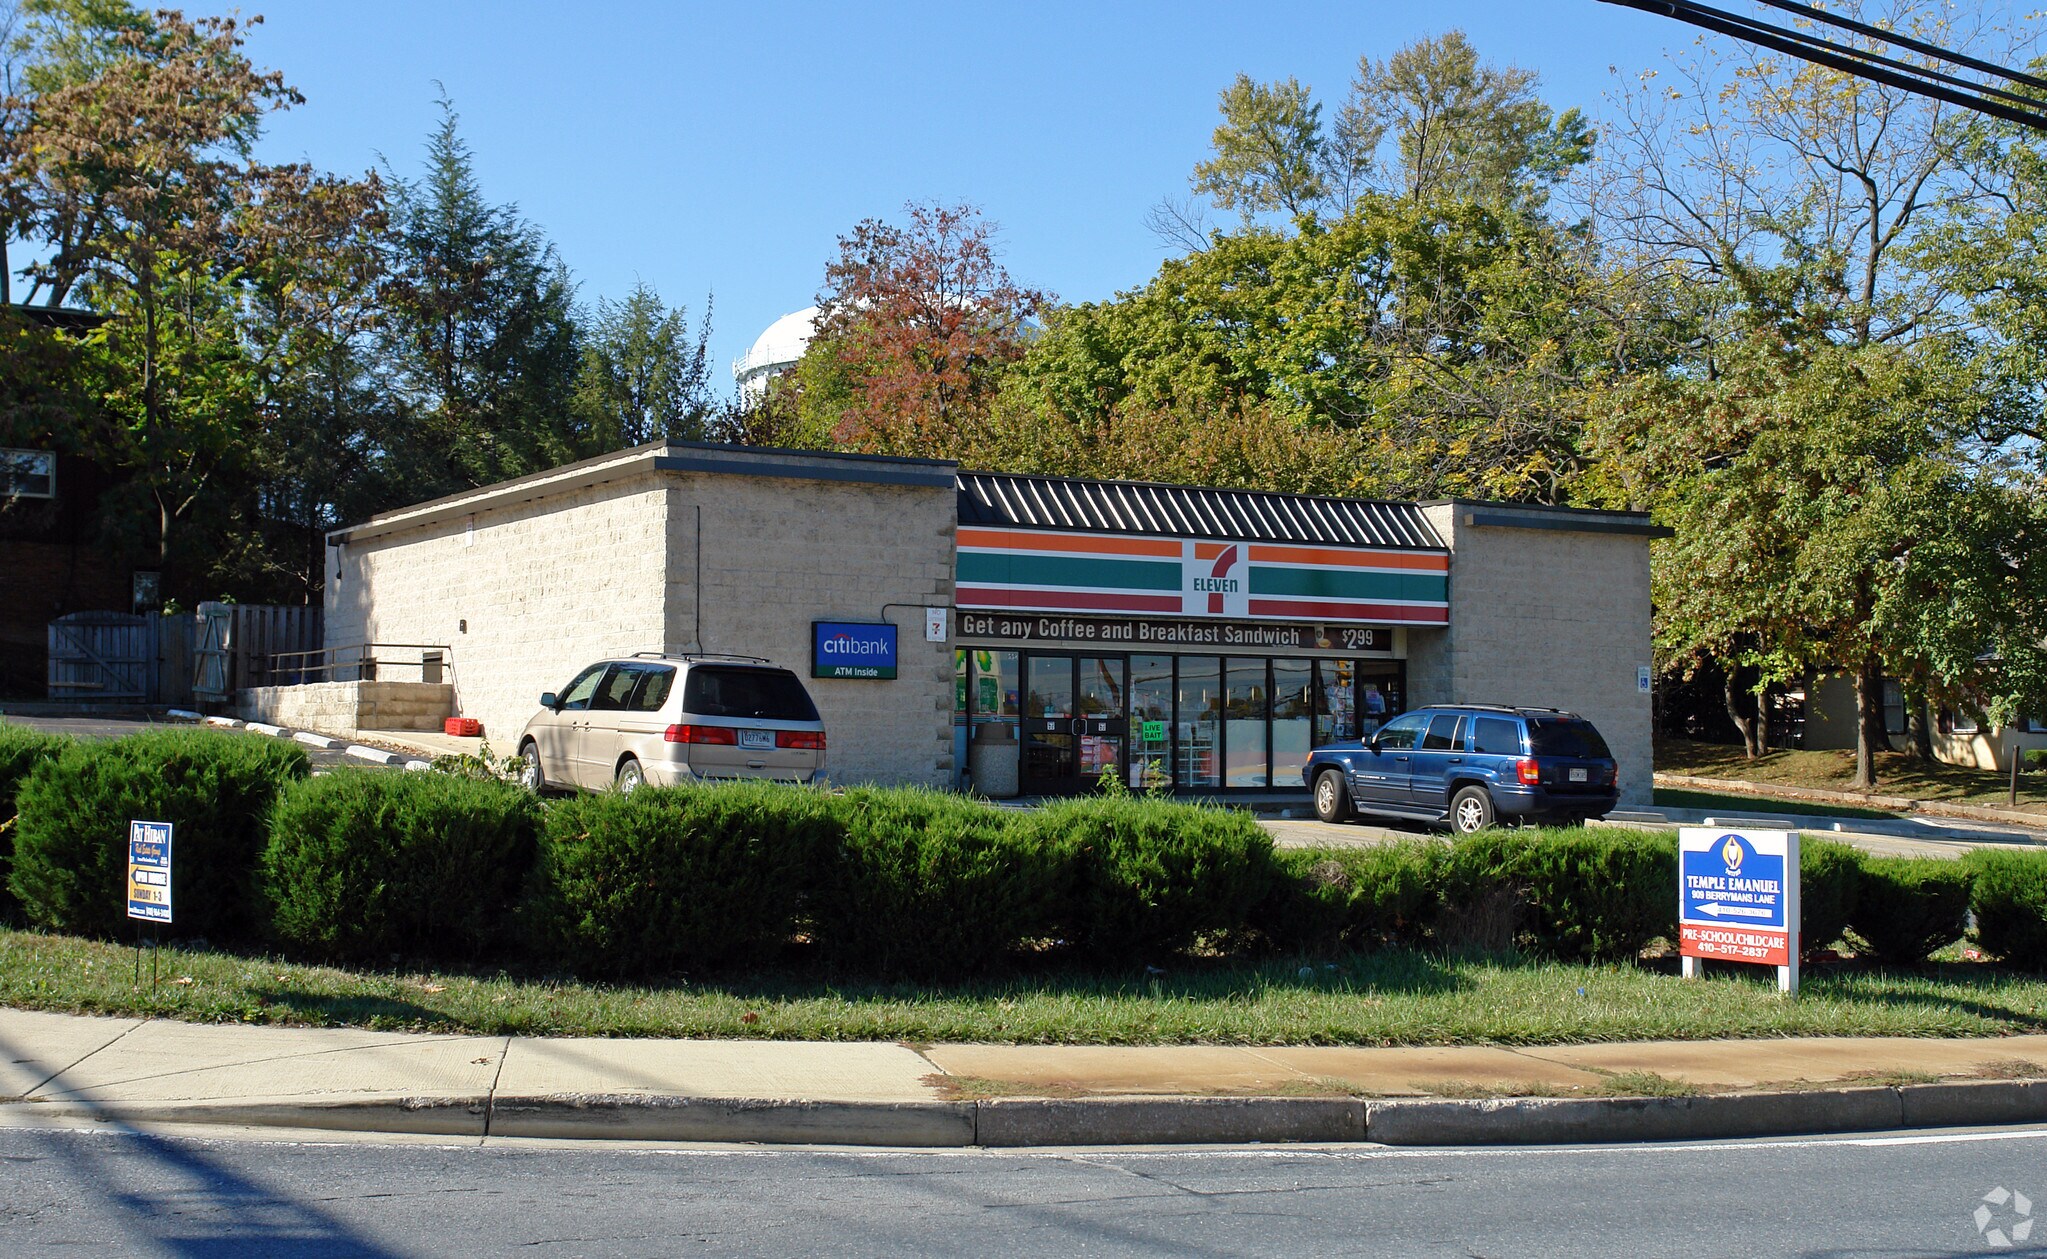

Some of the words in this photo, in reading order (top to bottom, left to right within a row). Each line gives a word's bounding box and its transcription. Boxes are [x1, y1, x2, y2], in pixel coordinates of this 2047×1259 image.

[1195, 543, 1237, 613] 7
[963, 615, 994, 635] Get
[1000, 620, 1032, 639] any
[1039, 618, 1096, 639] Coffee
[1101, 620, 1134, 641] and
[1139, 622, 1219, 644] Breakfast
[1224, 624, 1300, 645] Sandwich
[823, 634, 889, 655] citibank
[834, 667, 852, 676] ATM
[854, 667, 878, 677] Inside
[1687, 876, 1726, 890] TEMPLE
[1728, 878, 1780, 894] EMANUEL
[134, 889, 151, 900] SUNDAY
[1691, 889, 1705, 900] 909
[1706, 890, 1754, 903] BERRYMANS
[1754, 894, 1776, 905] LANE
[1682, 929, 1785, 949] PRE-SCHOOL/CHILDCARE
[1697, 942, 1769, 958] 410-517-2837
